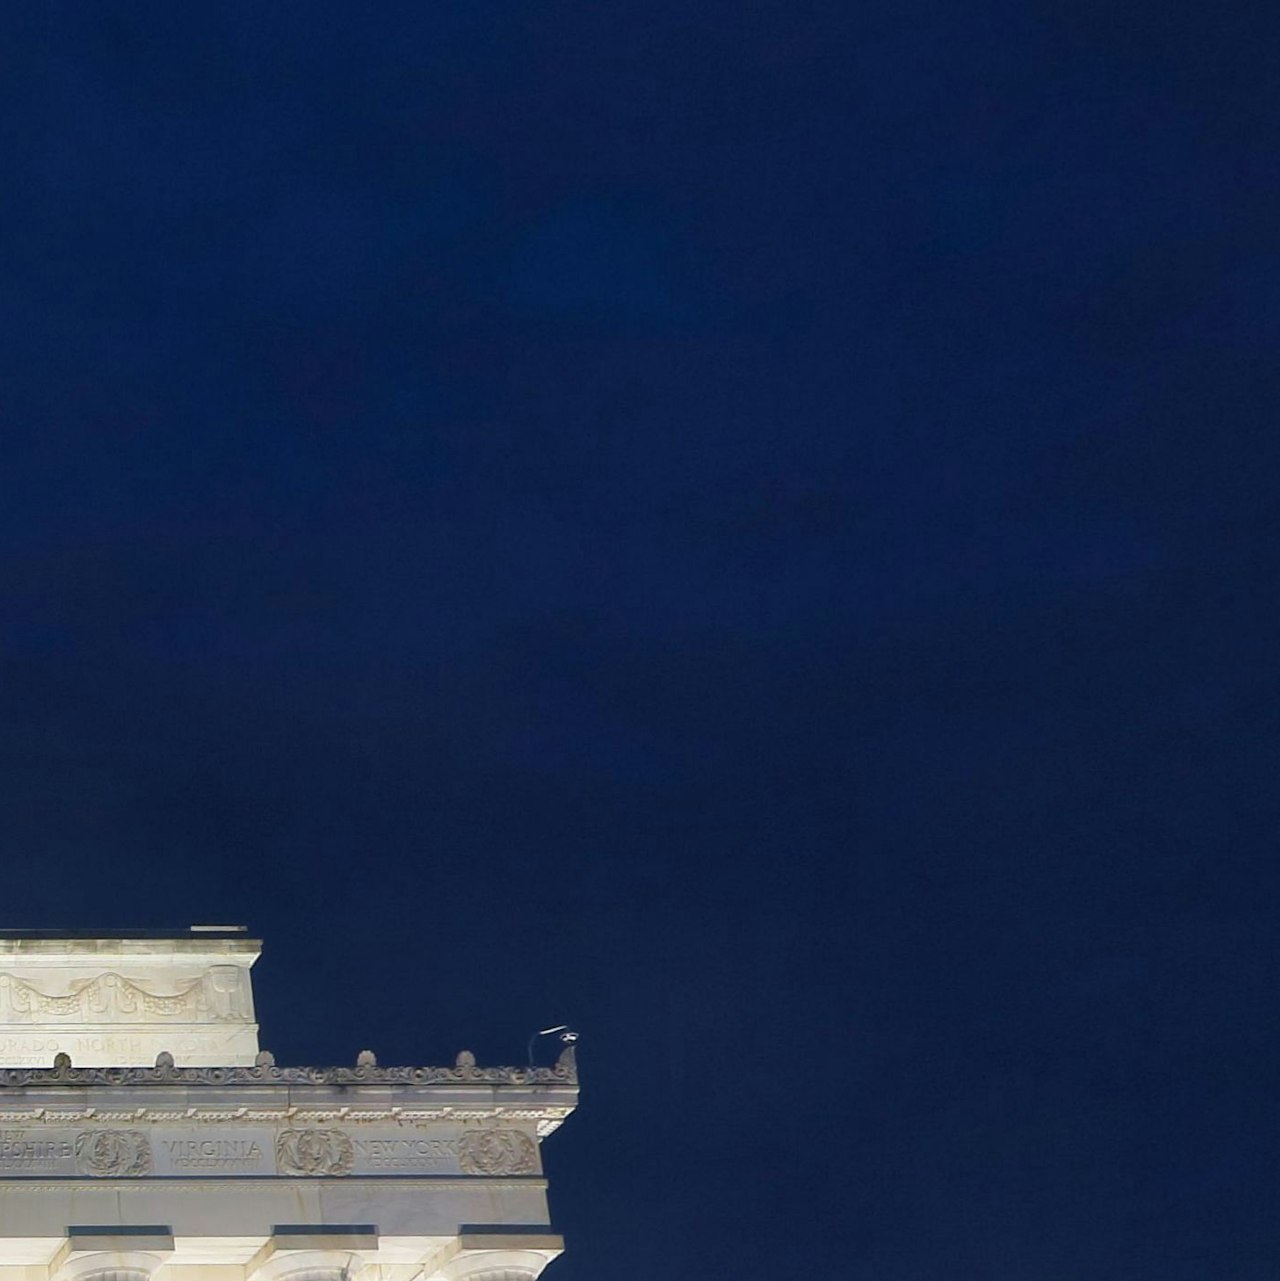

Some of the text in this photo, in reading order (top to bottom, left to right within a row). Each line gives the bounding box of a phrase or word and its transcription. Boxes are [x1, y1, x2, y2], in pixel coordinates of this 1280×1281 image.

[162, 1141, 261, 1158] VIRGINIA
[354, 1140, 458, 1157] NEW YORK
